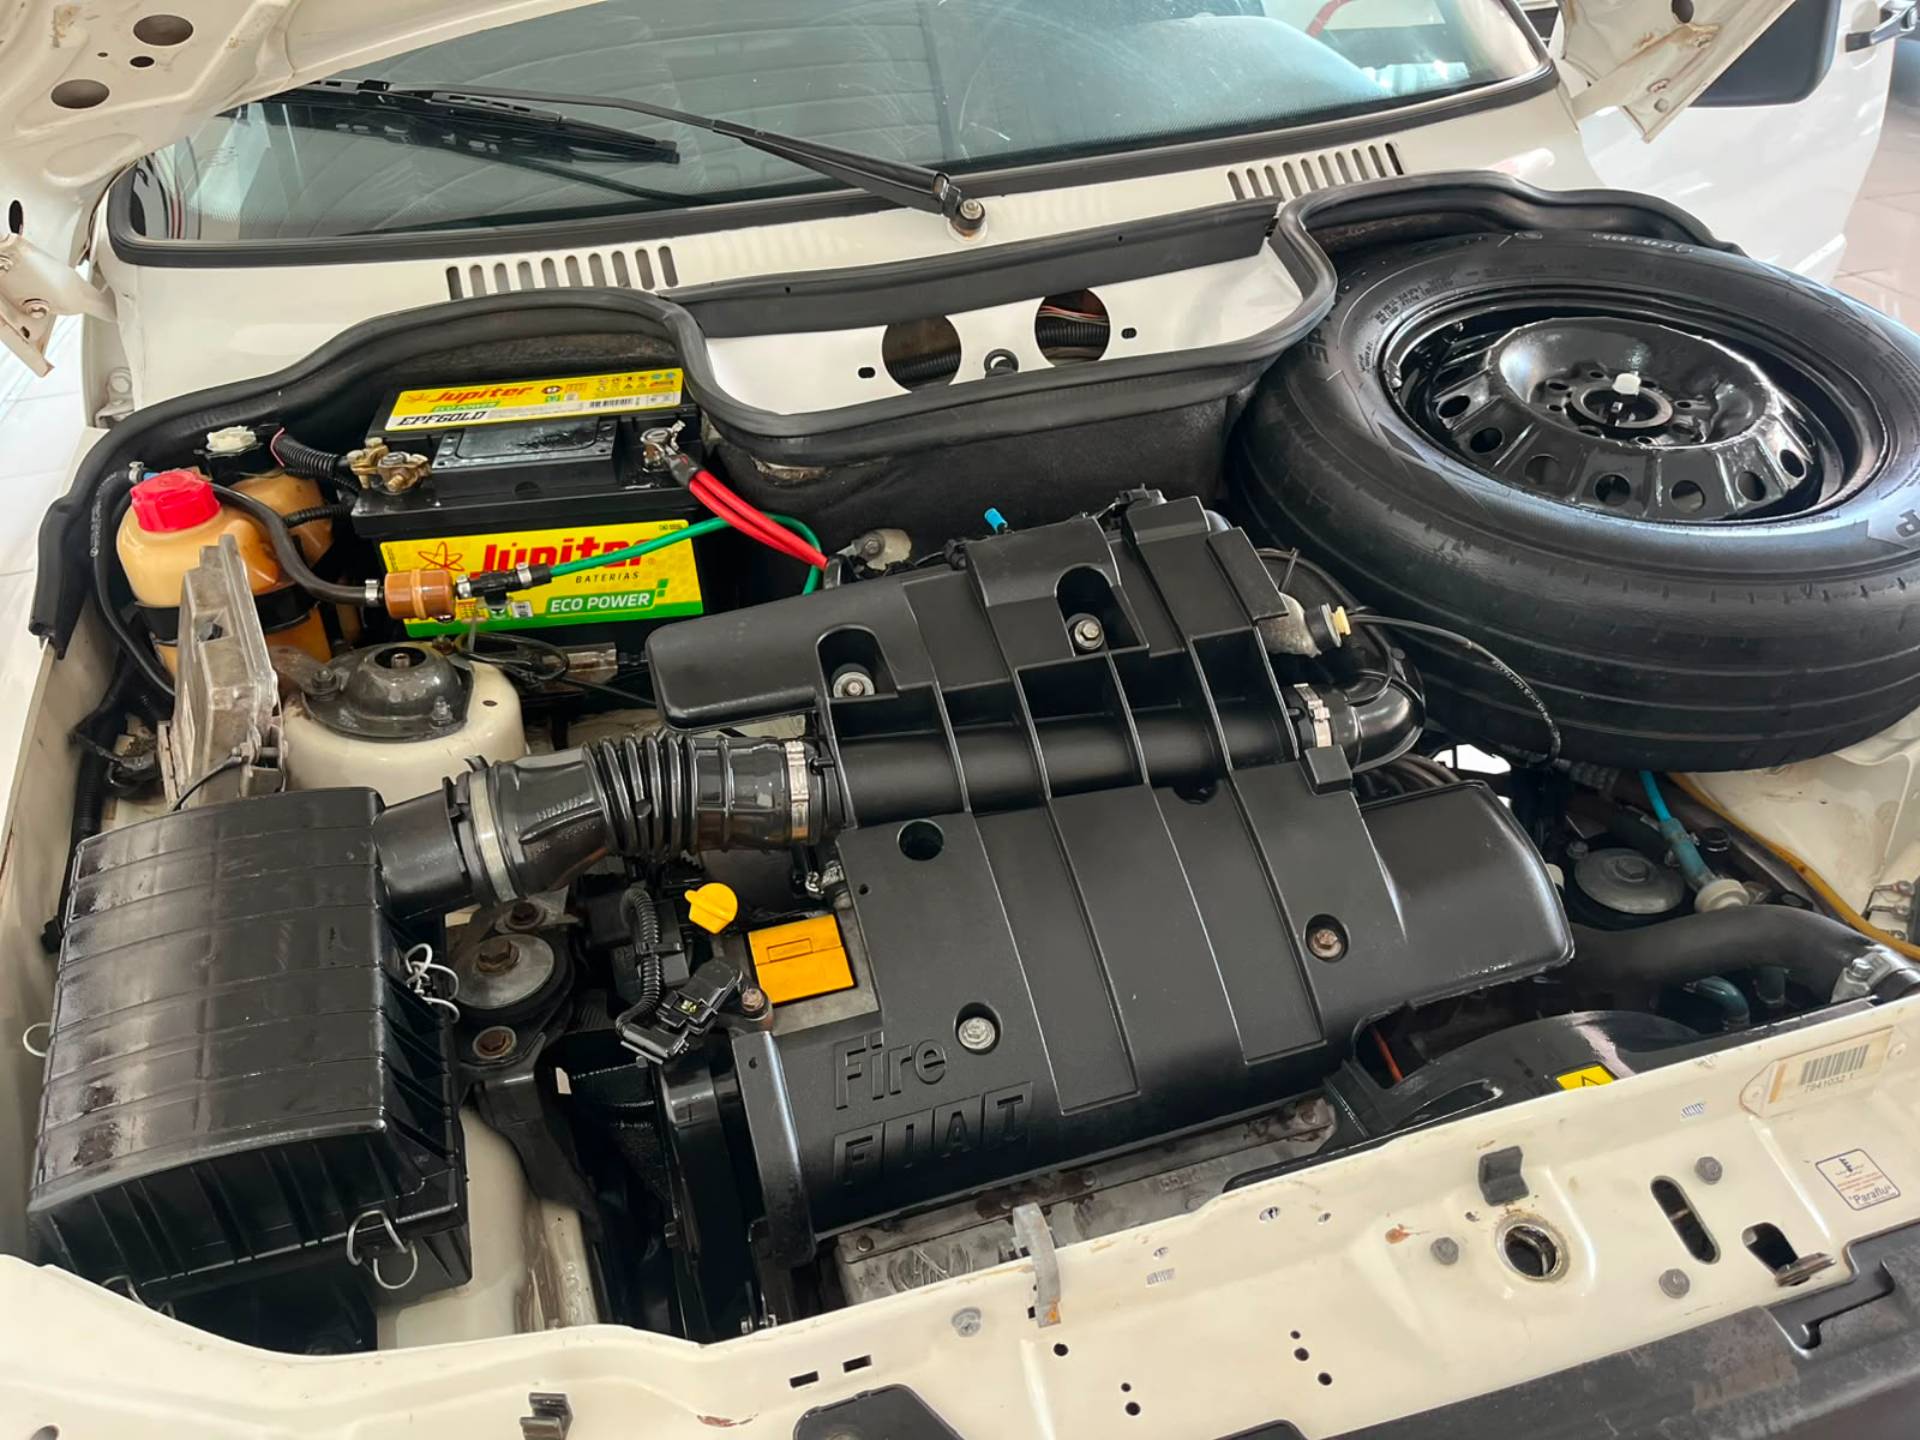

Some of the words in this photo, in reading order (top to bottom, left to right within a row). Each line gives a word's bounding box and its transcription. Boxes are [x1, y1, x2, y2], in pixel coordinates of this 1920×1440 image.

[575, 570, 640, 584] BATERIAS
[550, 599, 583, 613] ECO
[587, 592, 650, 610] POWER
[834, 1030, 945, 1110] Fire
[833, 1080, 1033, 1184] FIAT
